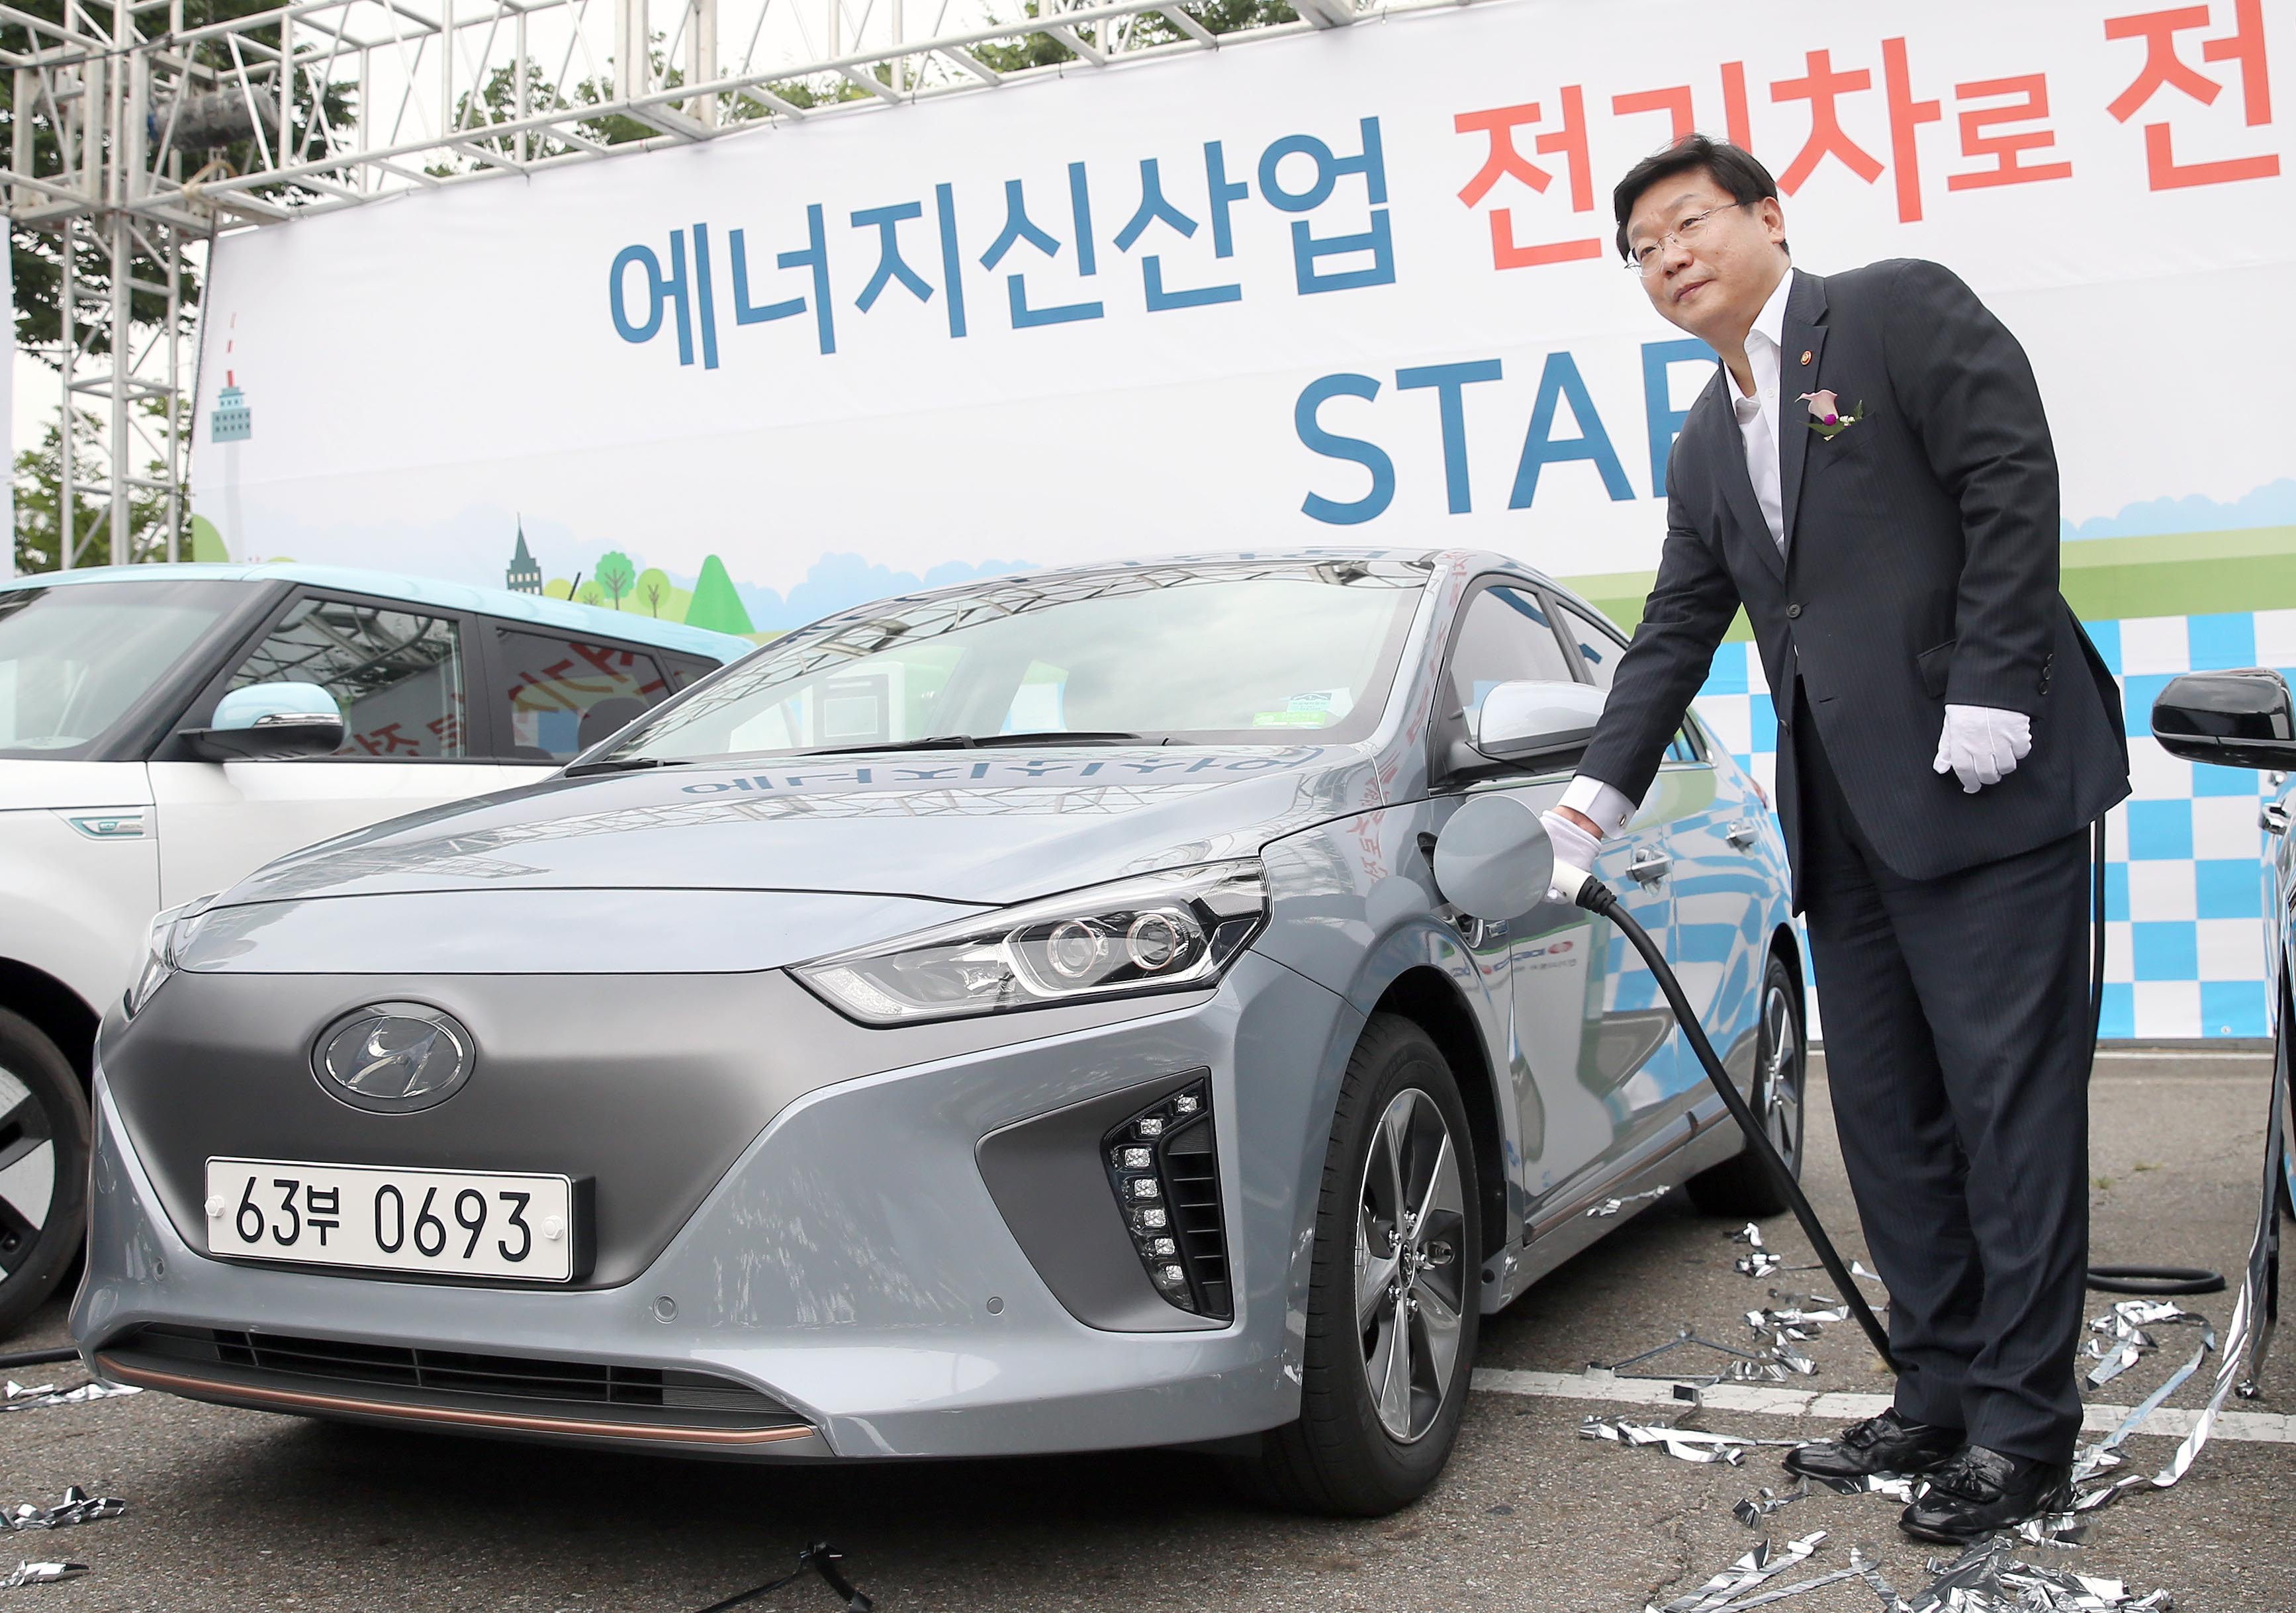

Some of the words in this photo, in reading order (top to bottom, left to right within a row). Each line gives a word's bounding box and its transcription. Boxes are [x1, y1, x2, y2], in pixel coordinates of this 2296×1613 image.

[610, 116, 1396, 369] 에너지신산업
[236, 1176, 340, 1246] 63부
[375, 1184, 531, 1262] 0693
